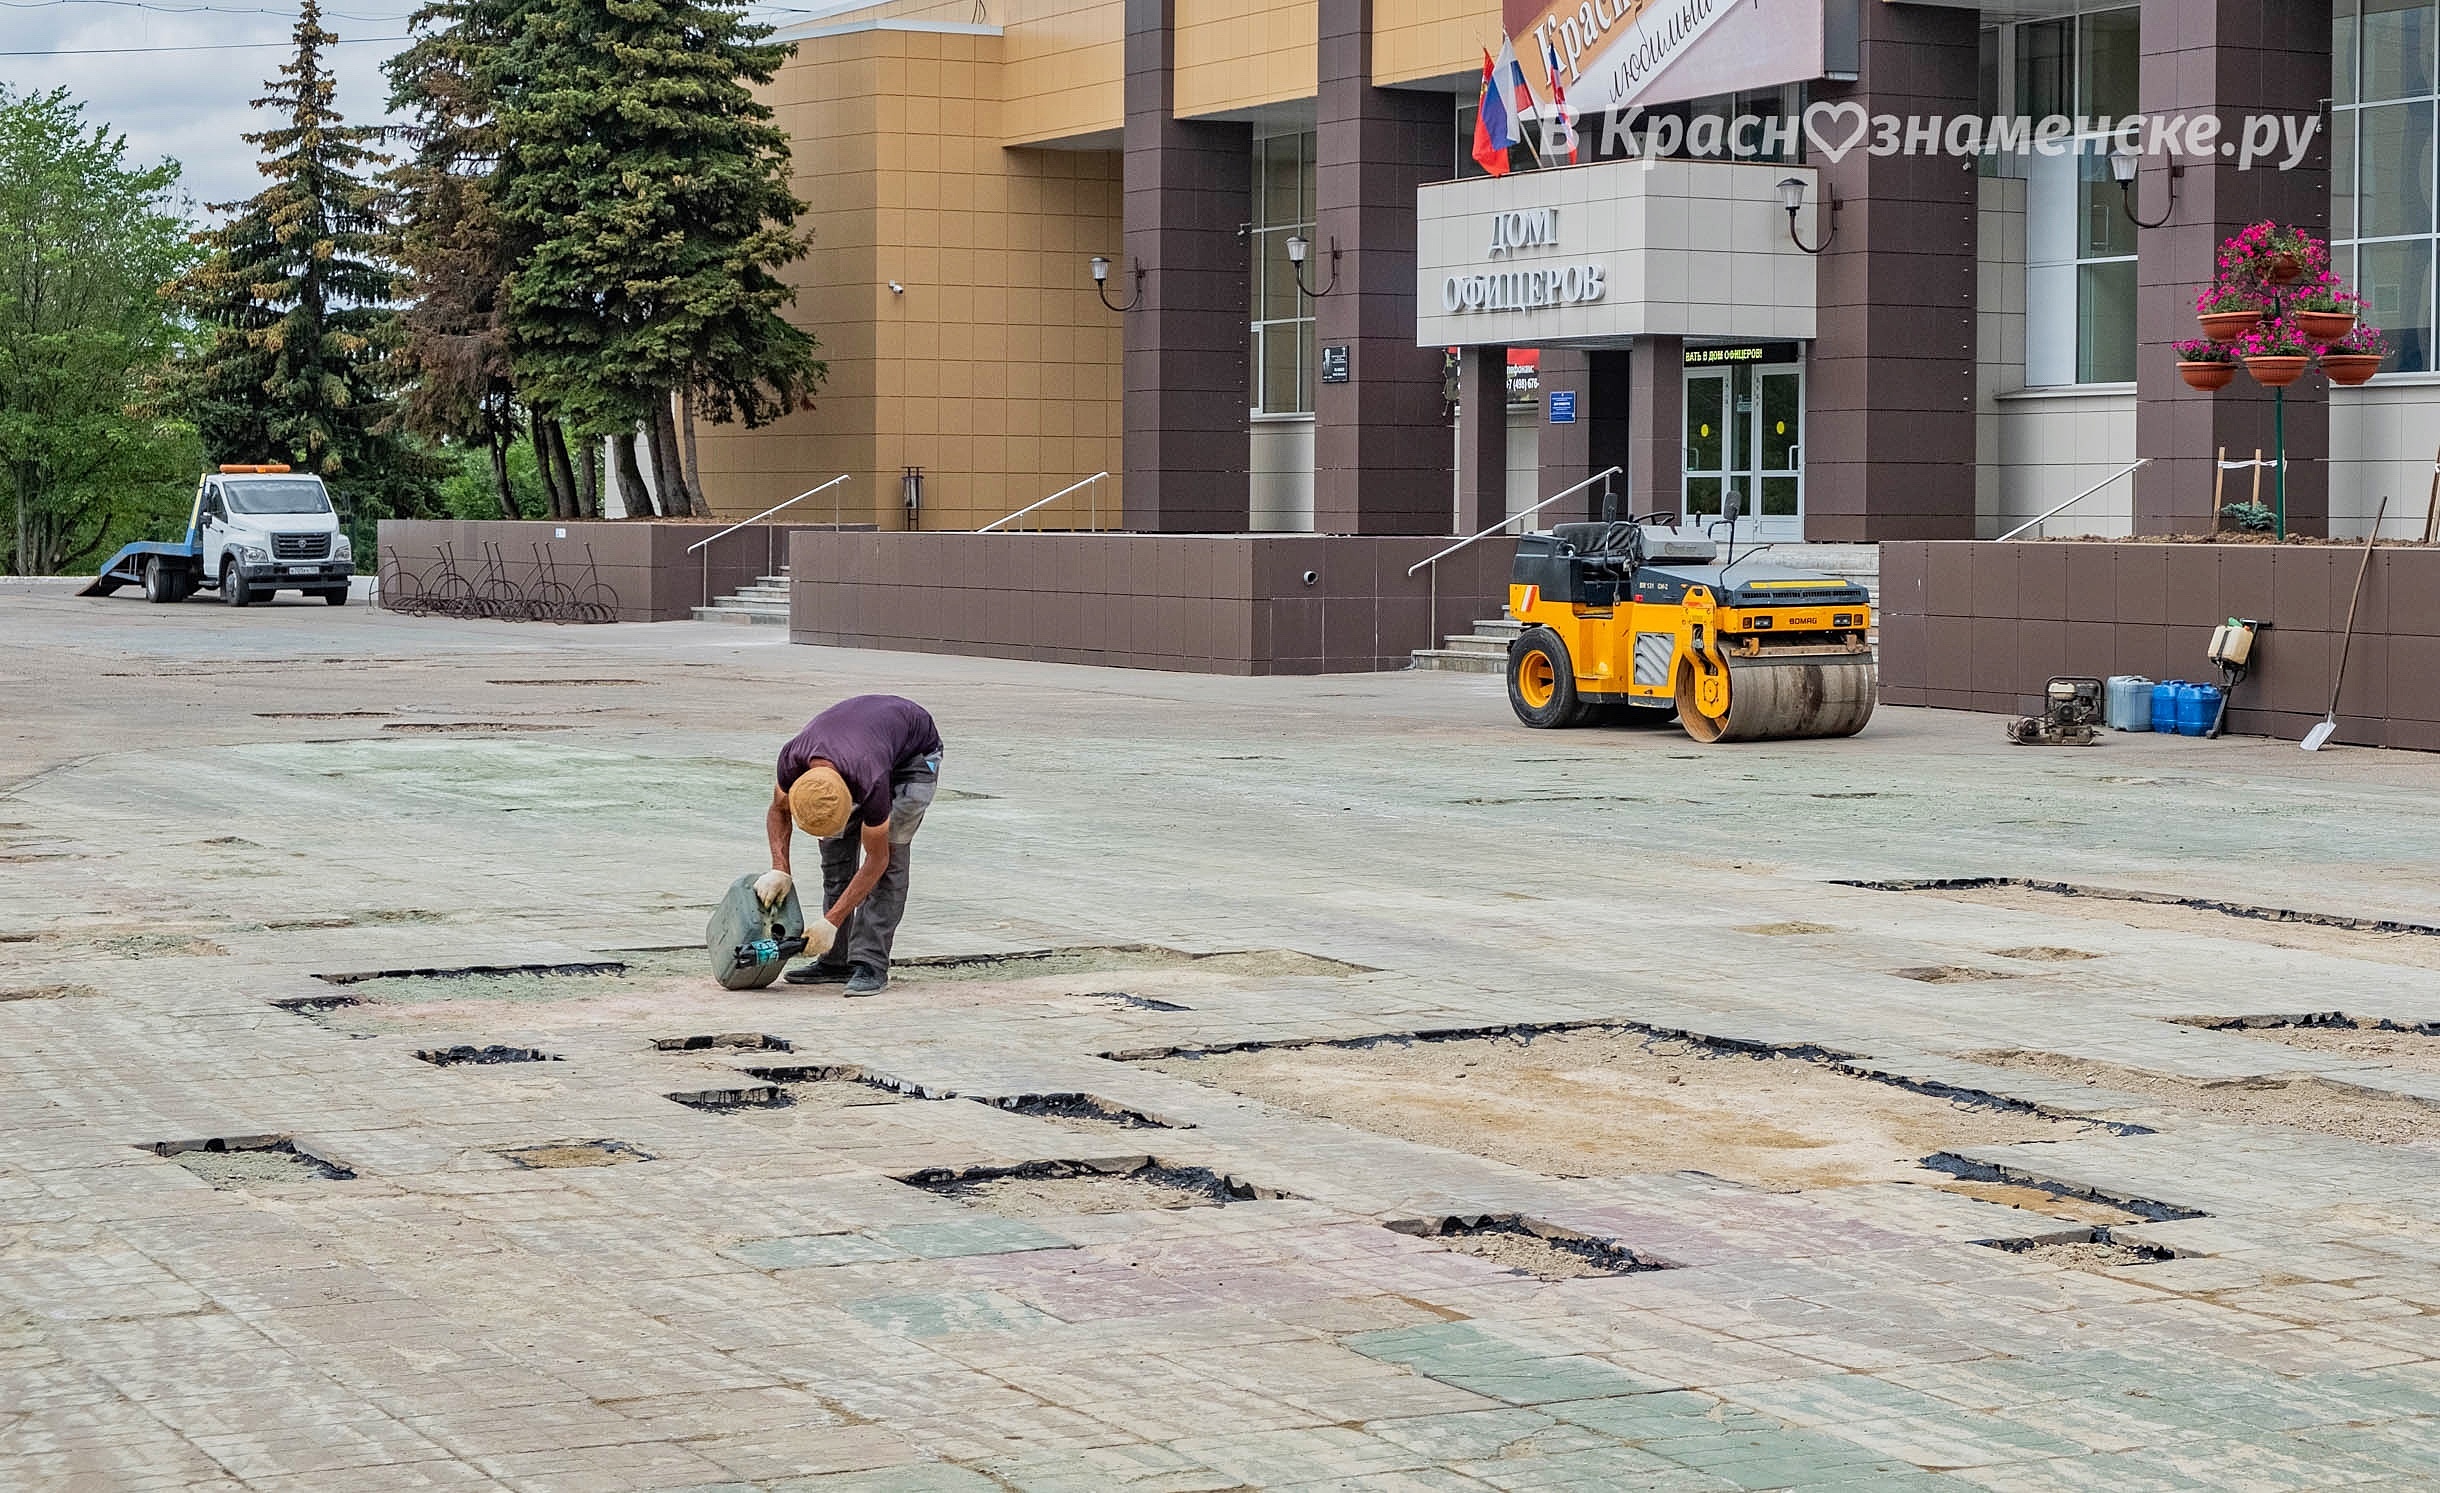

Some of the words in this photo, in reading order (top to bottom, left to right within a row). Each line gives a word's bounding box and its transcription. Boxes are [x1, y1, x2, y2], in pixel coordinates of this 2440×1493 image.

[1488, 208, 1559, 259] ДОМ
[1442, 264, 1606, 317] ОФИЦЕРОВ
[1708, 350, 1724, 362] ДОМ
[1789, 617, 1817, 625] BOMAG
